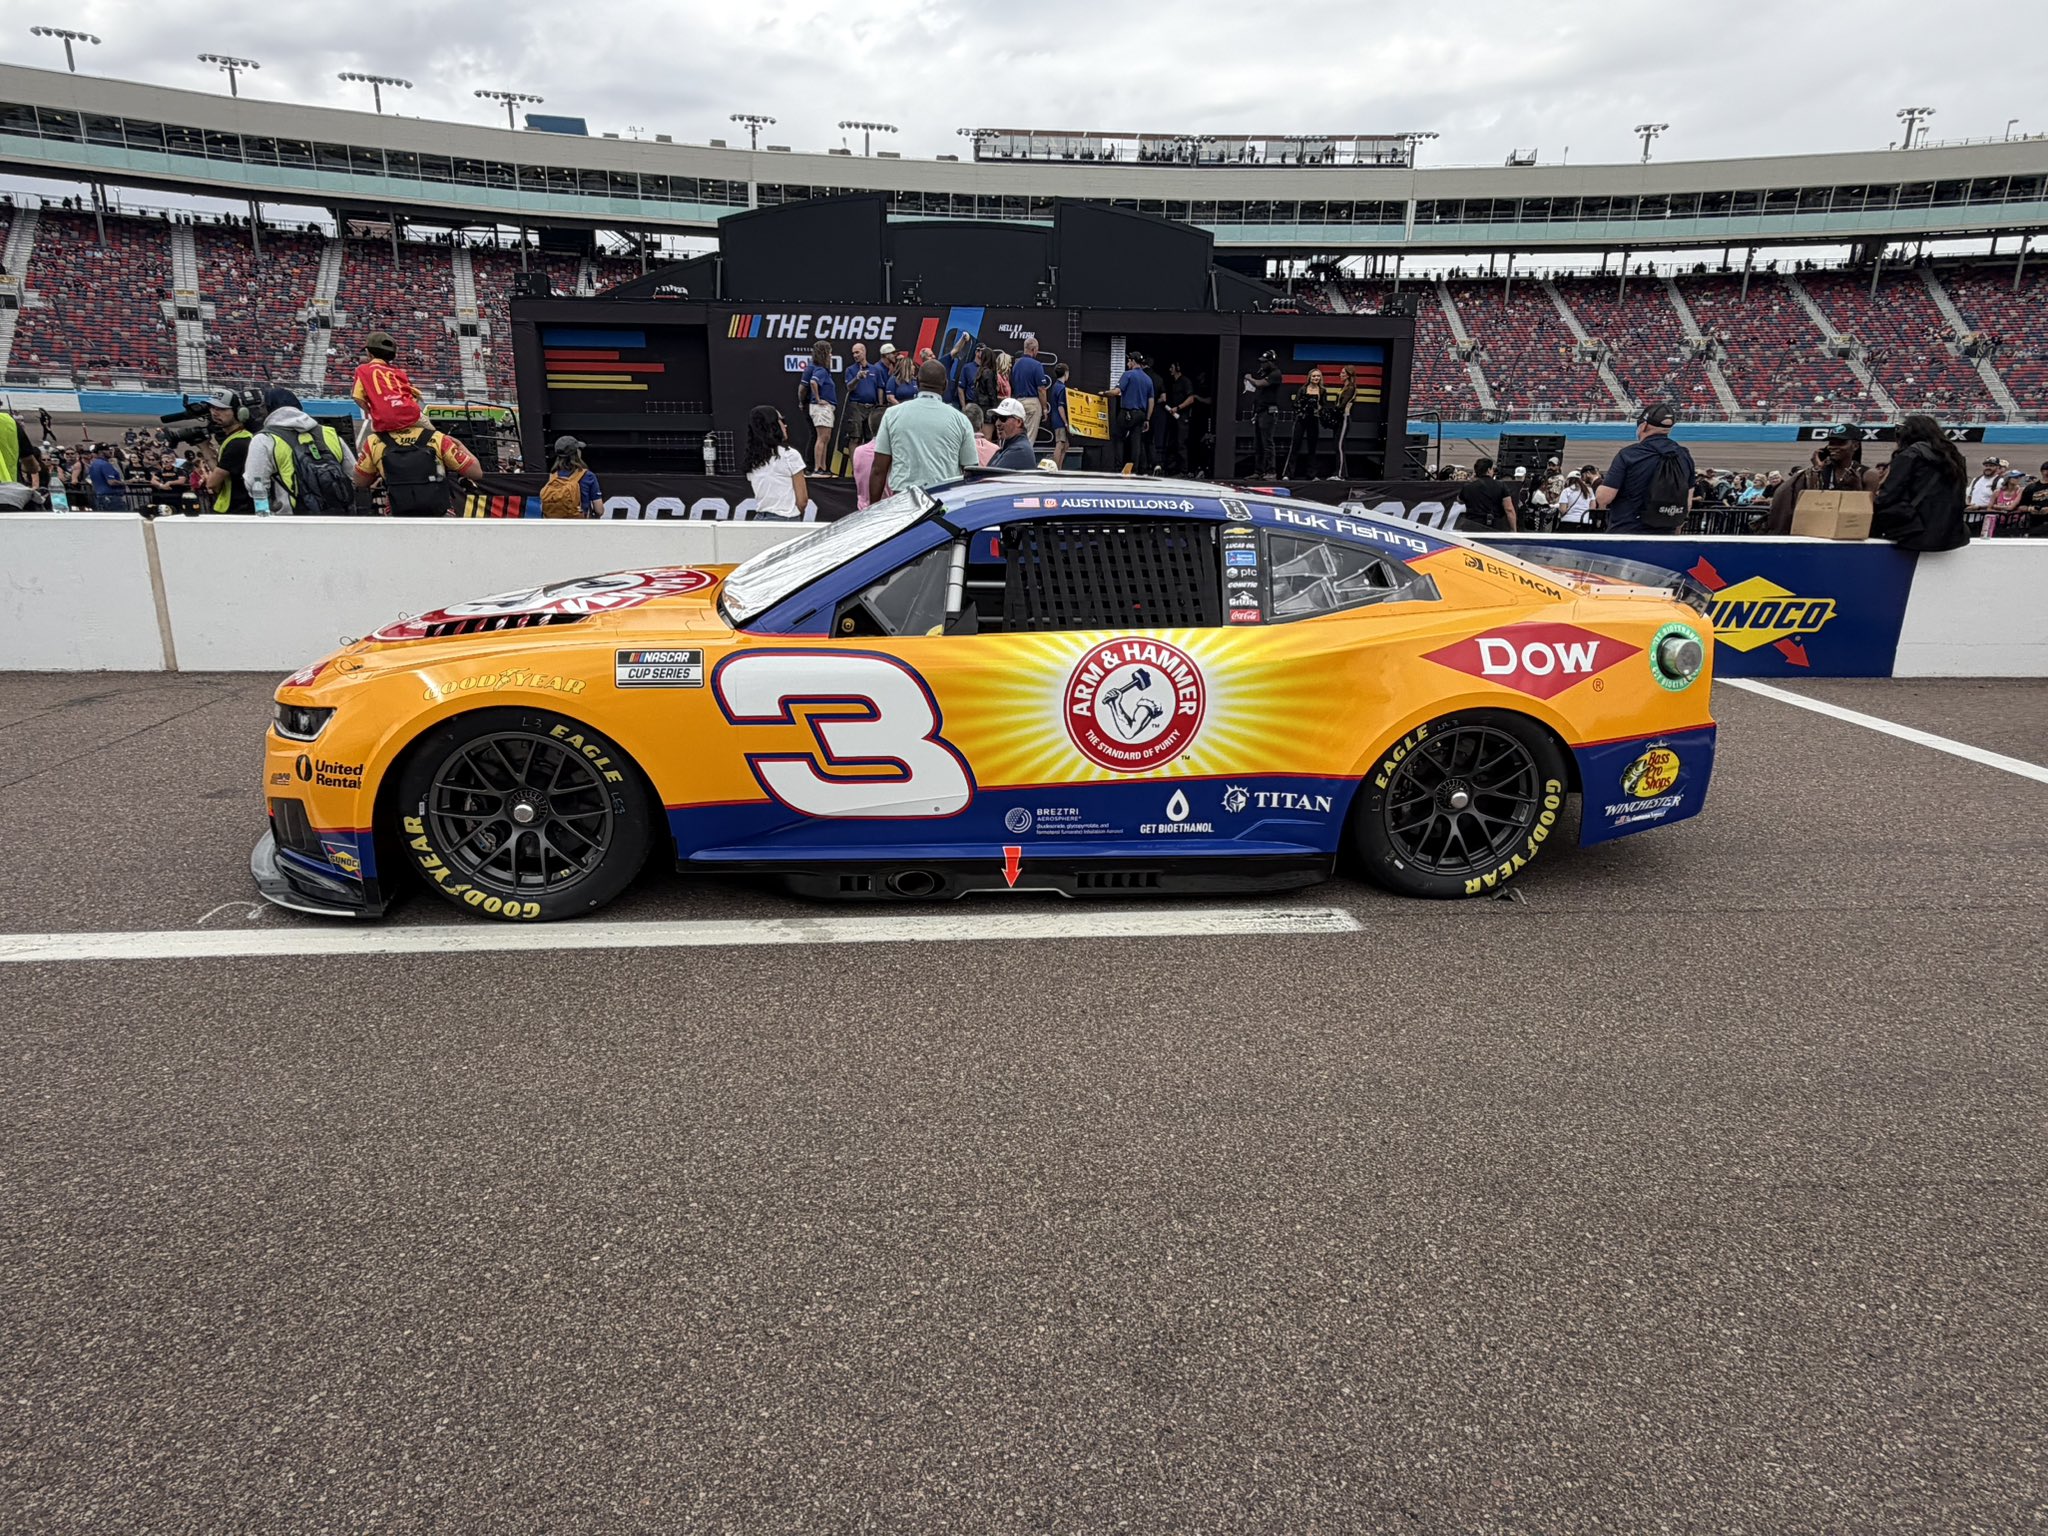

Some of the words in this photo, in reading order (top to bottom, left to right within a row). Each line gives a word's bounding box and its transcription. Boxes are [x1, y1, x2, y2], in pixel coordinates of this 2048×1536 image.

[766, 314, 811, 339] THE
[815, 316, 896, 340] CHASE
[1061, 498, 1178, 510] AUSTINDILLON3
[1241, 568, 1258, 578] ptc
[1486, 563, 1562, 600] BETMGM
[1709, 601, 1830, 629] UNOCO
[643, 652, 690, 663] NASCAR
[423, 671, 587, 700] GOODYEAR
[628, 668, 651, 679] CUP
[652, 668, 691, 679] SERIES
[1072, 661, 1106, 717] ARM
[1101, 649, 1122, 669] &
[1121, 643, 1198, 716] HAMMER
[711, 647, 978, 819] 3
[1085, 729, 1098, 746] THE
[1097, 742, 1142, 760] STANDARD
[1143, 748, 1155, 759] OF
[1155, 728, 1181, 752] PURITY
[550, 724, 623, 783] EAGLE
[1375, 724, 1430, 790] EAGLE
[1648, 751, 1671, 766] Bass
[316, 759, 364, 776] United
[1646, 764, 1664, 779] Pro
[1642, 776, 1672, 792] Shops
[1254, 792, 1333, 813] TITAN
[1604, 795, 1682, 817] WINCHESTER
[1140, 824, 1156, 834] GET
[1158, 823, 1214, 834] BIOETHANOL
[1465, 779, 1561, 895] GOODYEAR
[404, 815, 541, 919] GOODYEAR
